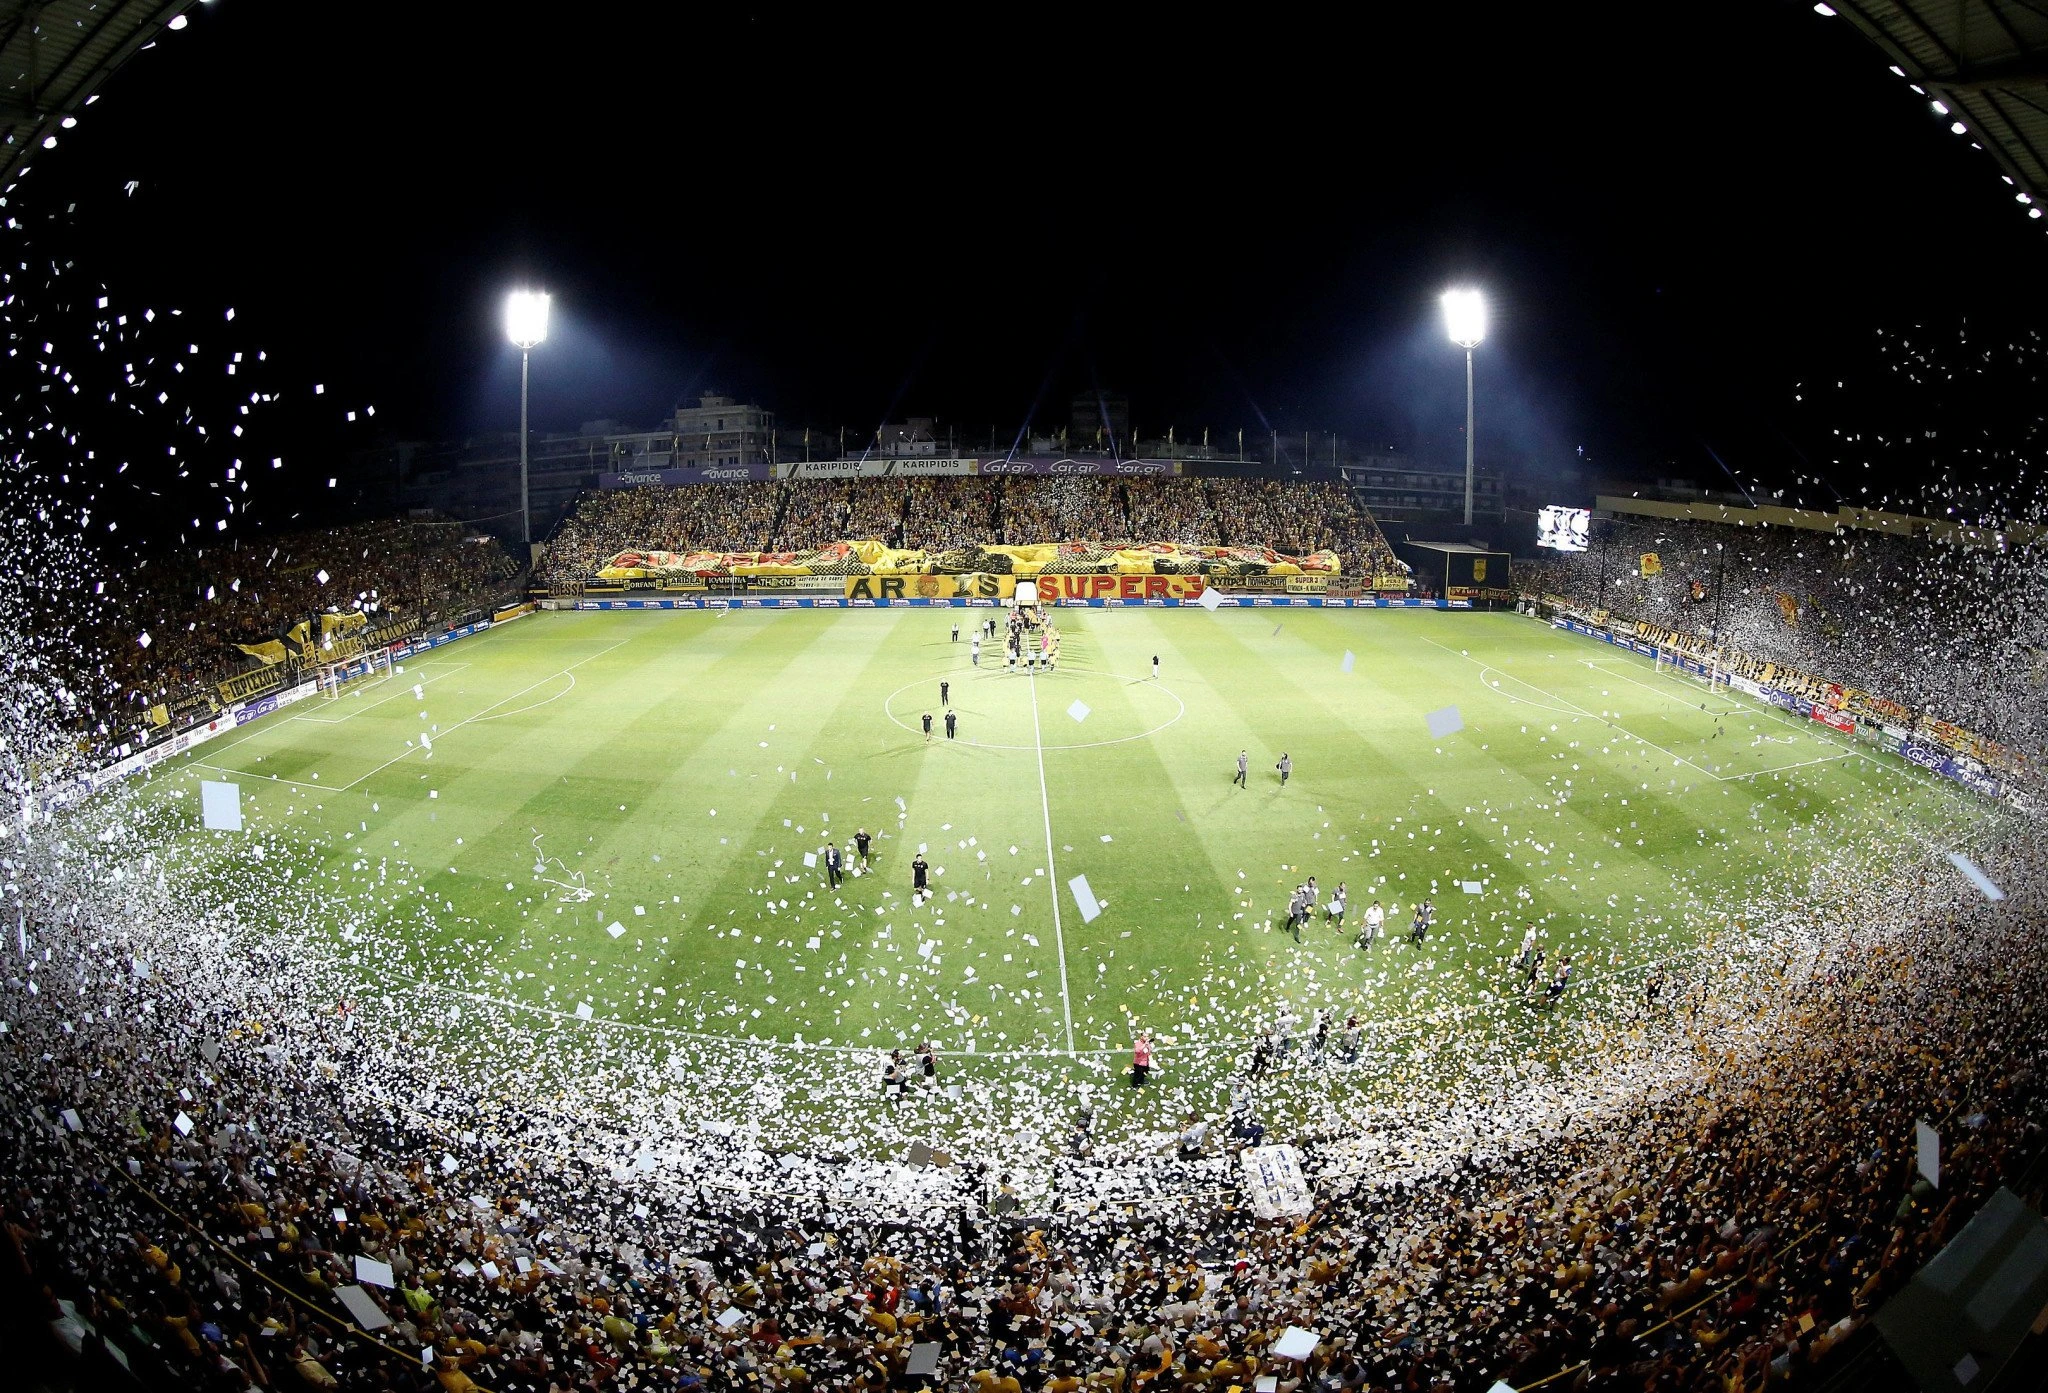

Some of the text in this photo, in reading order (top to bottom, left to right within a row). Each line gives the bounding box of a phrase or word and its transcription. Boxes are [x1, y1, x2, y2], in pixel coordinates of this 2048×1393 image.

[805, 462, 860, 471] KARIPIDIS
[903, 460, 959, 468] KARIPIDIS
[624, 472, 662, 484] avance
[709, 467, 750, 479] avance
[548, 582, 584, 597] EDESSA
